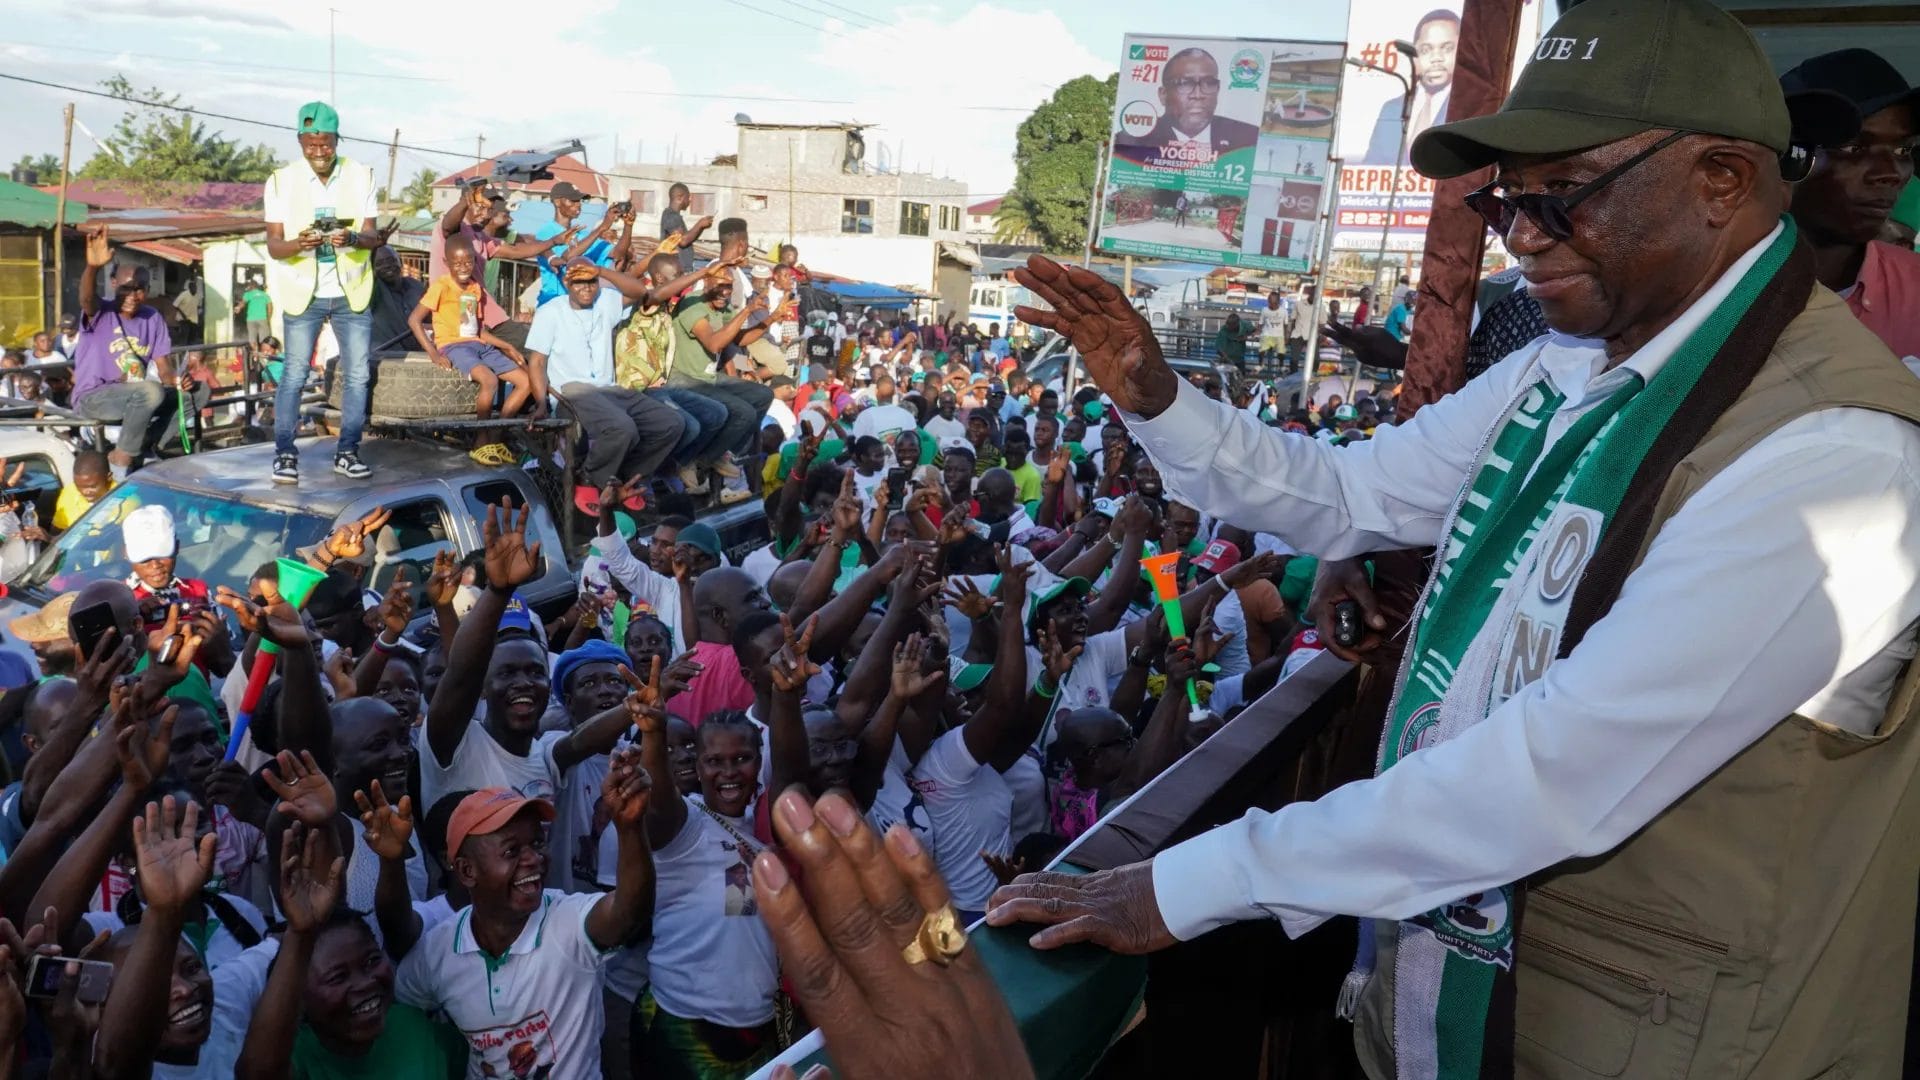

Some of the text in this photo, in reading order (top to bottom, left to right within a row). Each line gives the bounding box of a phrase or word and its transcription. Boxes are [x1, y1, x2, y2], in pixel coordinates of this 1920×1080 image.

[1145, 48, 1168, 59] VOTE
[1360, 41, 1398, 74] #6
[1532, 37, 1599, 62] UE 1
[1132, 63, 1159, 84] #21
[1124, 113, 1153, 127] VOTE
[1142, 165, 1181, 176] ELECTORAL
[1183, 168, 1217, 179] DISTRICT
[1153, 158, 1217, 170] REPRESENTATIVE
[1437, 932, 1493, 959] UNITY PARTY
